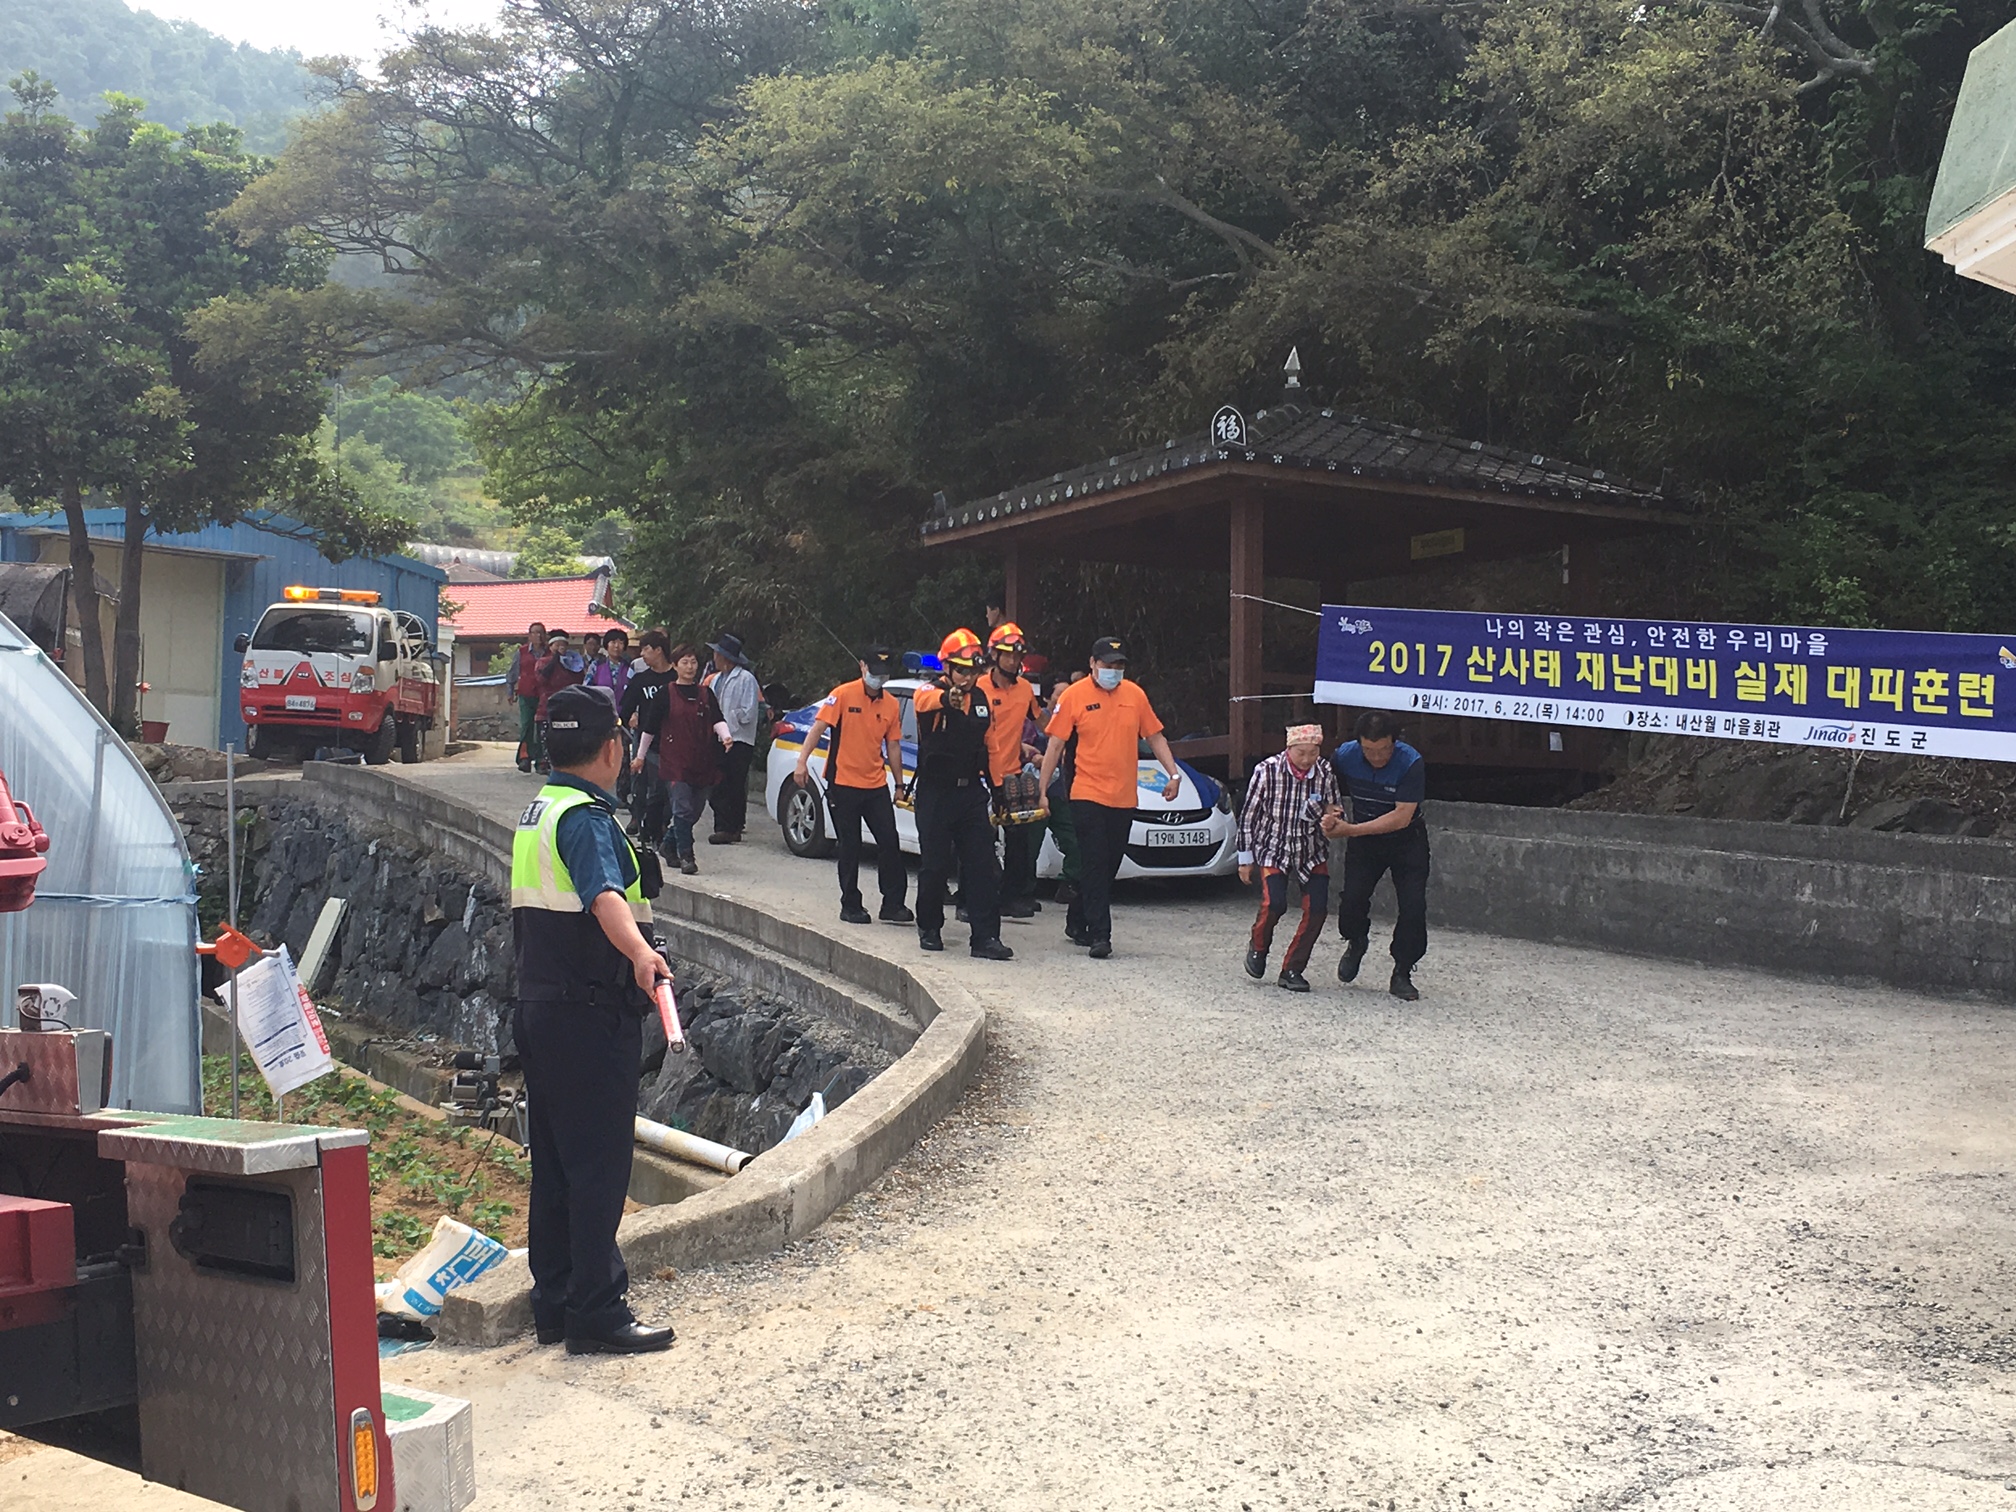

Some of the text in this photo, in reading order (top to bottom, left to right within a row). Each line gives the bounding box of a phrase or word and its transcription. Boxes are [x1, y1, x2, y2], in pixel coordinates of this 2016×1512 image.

[1485, 618, 1829, 657] 나의 작은 관심, 안전한 우리마을
[1368, 640, 1995, 718] 2017 산사태 재난대비 실제 대피훈련
[1421, 694, 1605, 723] 일시: 2017. 6. 22.(목) 14:00
[1636, 710, 1781, 738] 장소: 내산월 마을회관
[1803, 725, 1848, 743] Jindo
[1179, 831, 1205, 844] 3148
